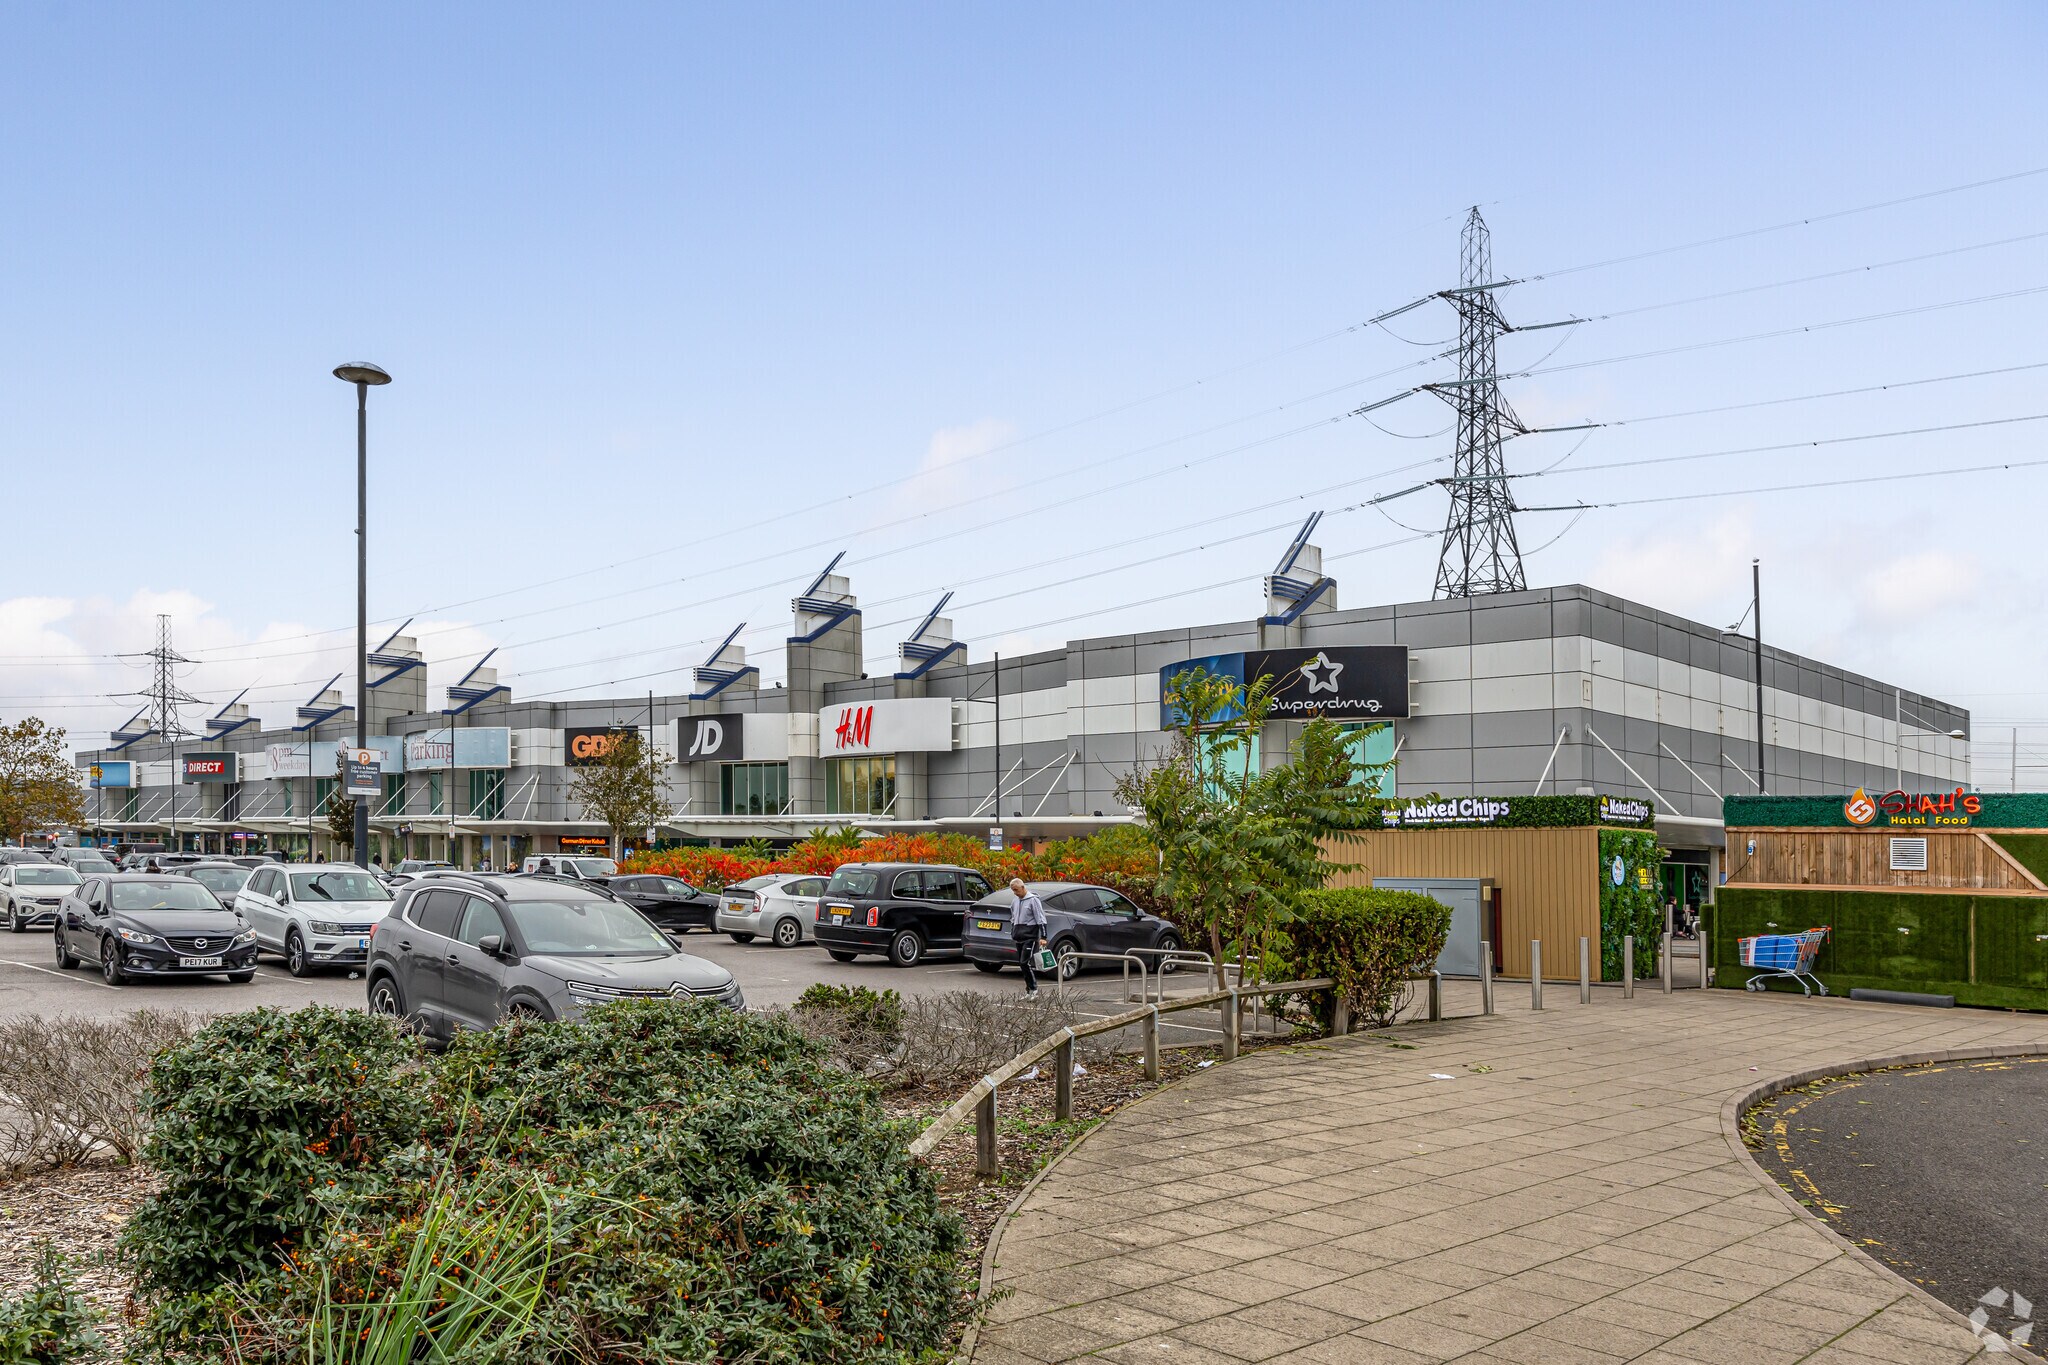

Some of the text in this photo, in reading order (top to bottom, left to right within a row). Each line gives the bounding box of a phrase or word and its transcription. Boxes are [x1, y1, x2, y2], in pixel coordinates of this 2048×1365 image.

[1267, 697, 1382, 713] Superdrug
[835, 705, 874, 749] H&M
[689, 720, 723, 756] JD
[411, 739, 453, 764] Parking
[189, 762, 222, 772] DIRECT
[1405, 797, 1510, 820] Naked Chips
[1610, 799, 1649, 821] Naked Chips
[1383, 817, 1400, 827] Chips
[1891, 816, 1968, 825] Halal Food
[185, 958, 217, 966] PE17 KUR
